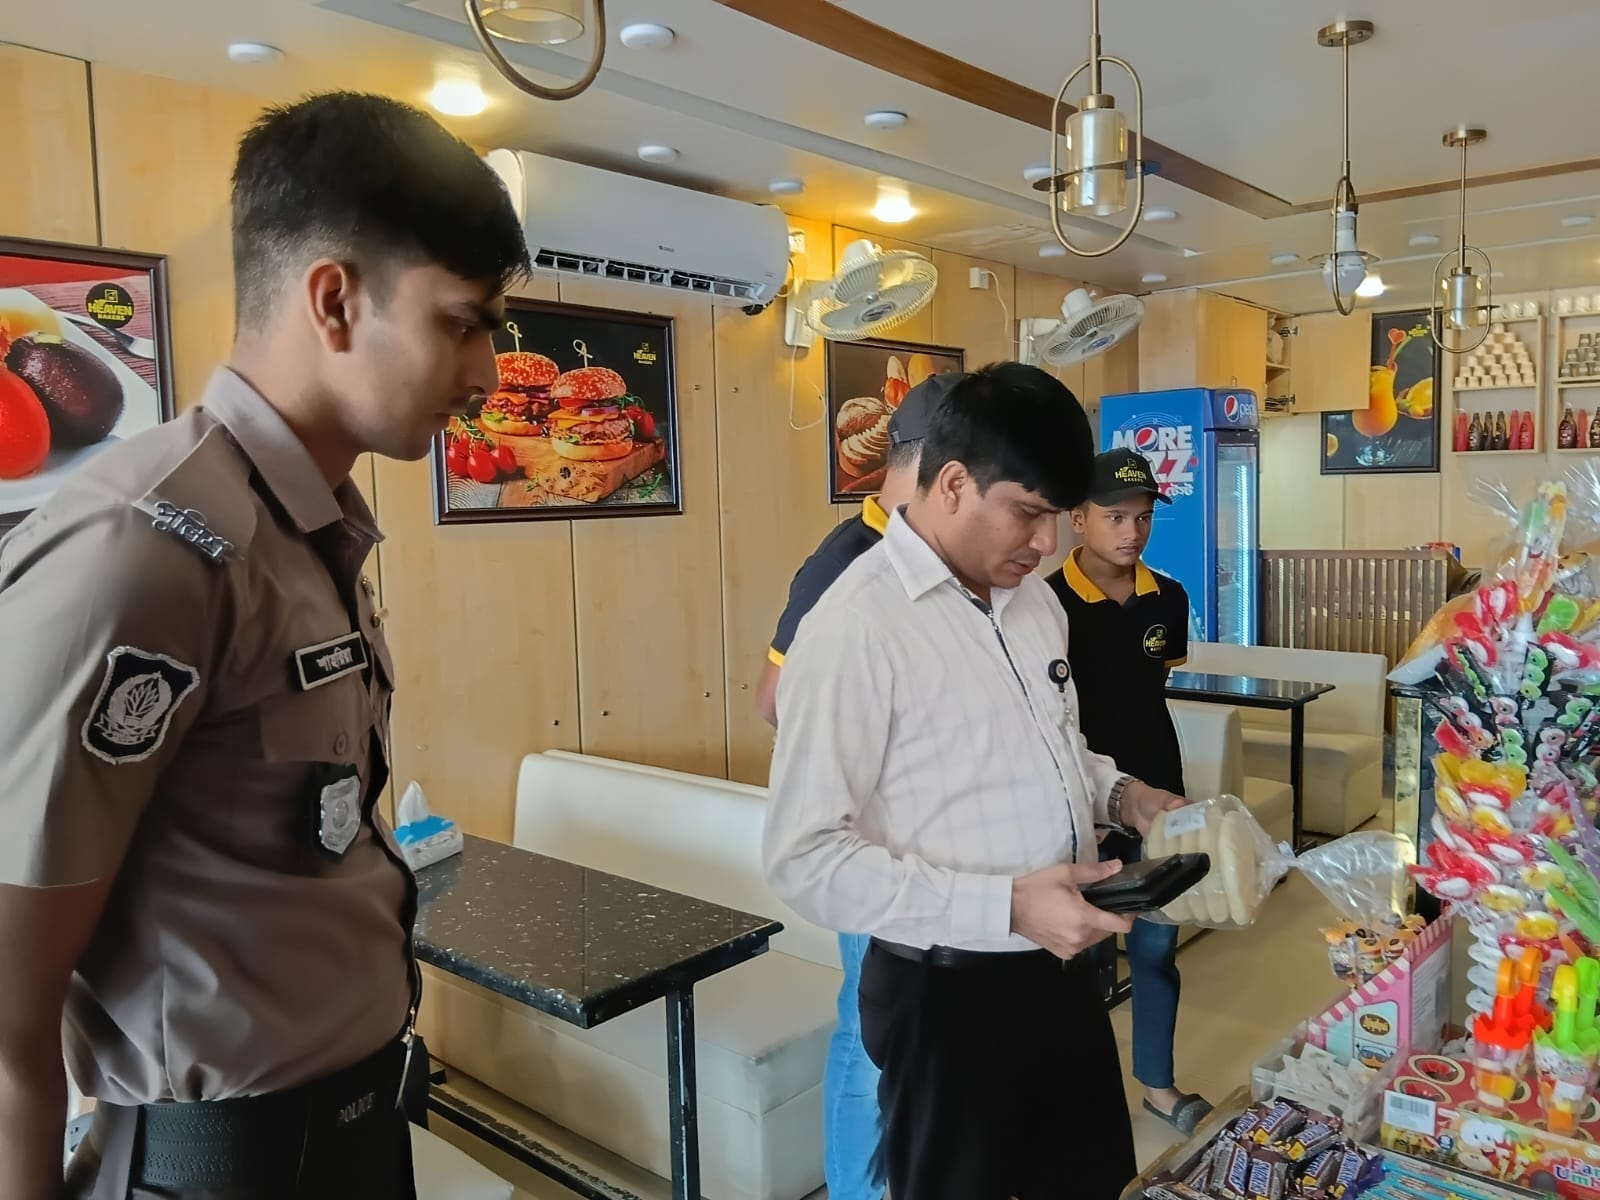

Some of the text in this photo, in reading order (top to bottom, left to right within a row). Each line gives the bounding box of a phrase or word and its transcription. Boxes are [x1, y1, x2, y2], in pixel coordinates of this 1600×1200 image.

[87, 301, 132, 316] HEAVEN
[1112, 425, 1193, 452] MORE
[1115, 467, 1147, 480] HEAVEN
[1141, 449, 1194, 483] ZZ
